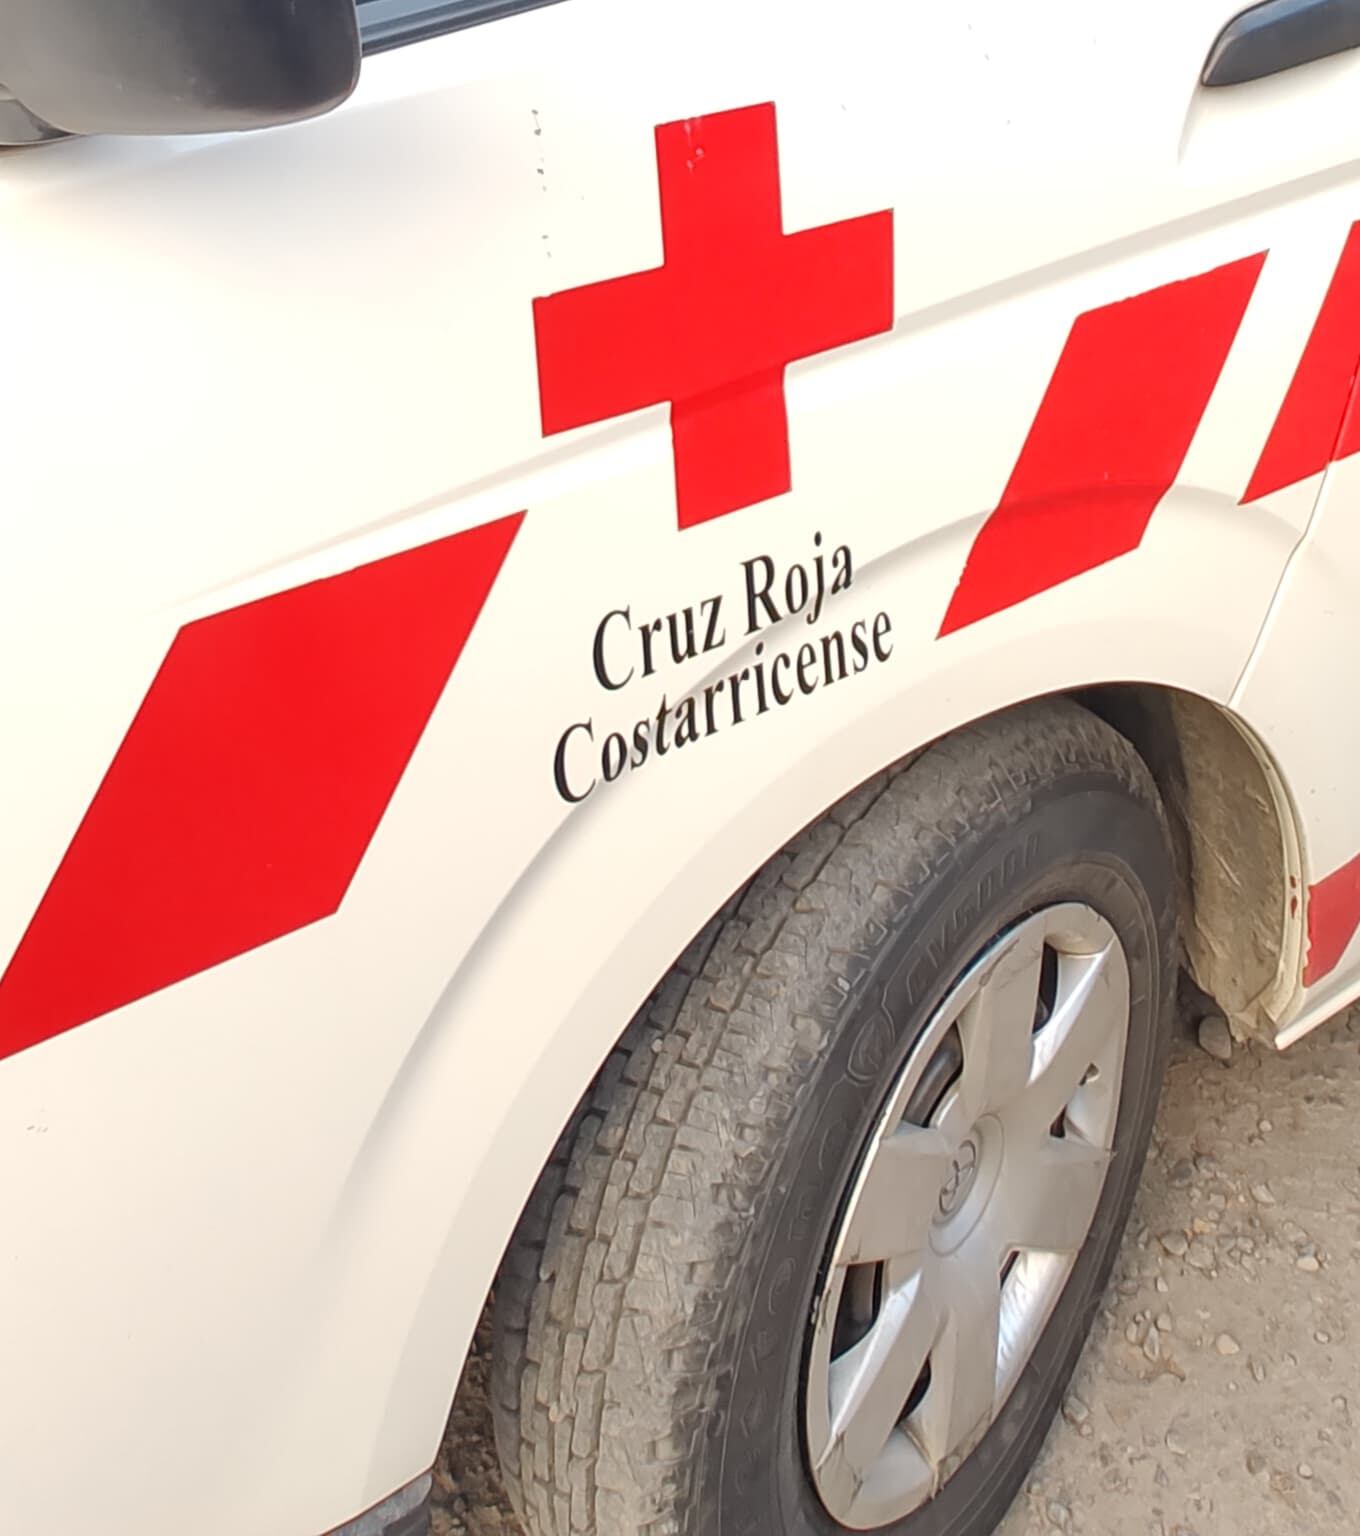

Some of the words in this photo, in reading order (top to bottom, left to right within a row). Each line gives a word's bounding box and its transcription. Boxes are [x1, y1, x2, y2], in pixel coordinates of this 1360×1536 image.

[592, 594, 727, 691] Cruz
[740, 531, 854, 635] Roja
[553, 610, 895, 803] Costarricense
